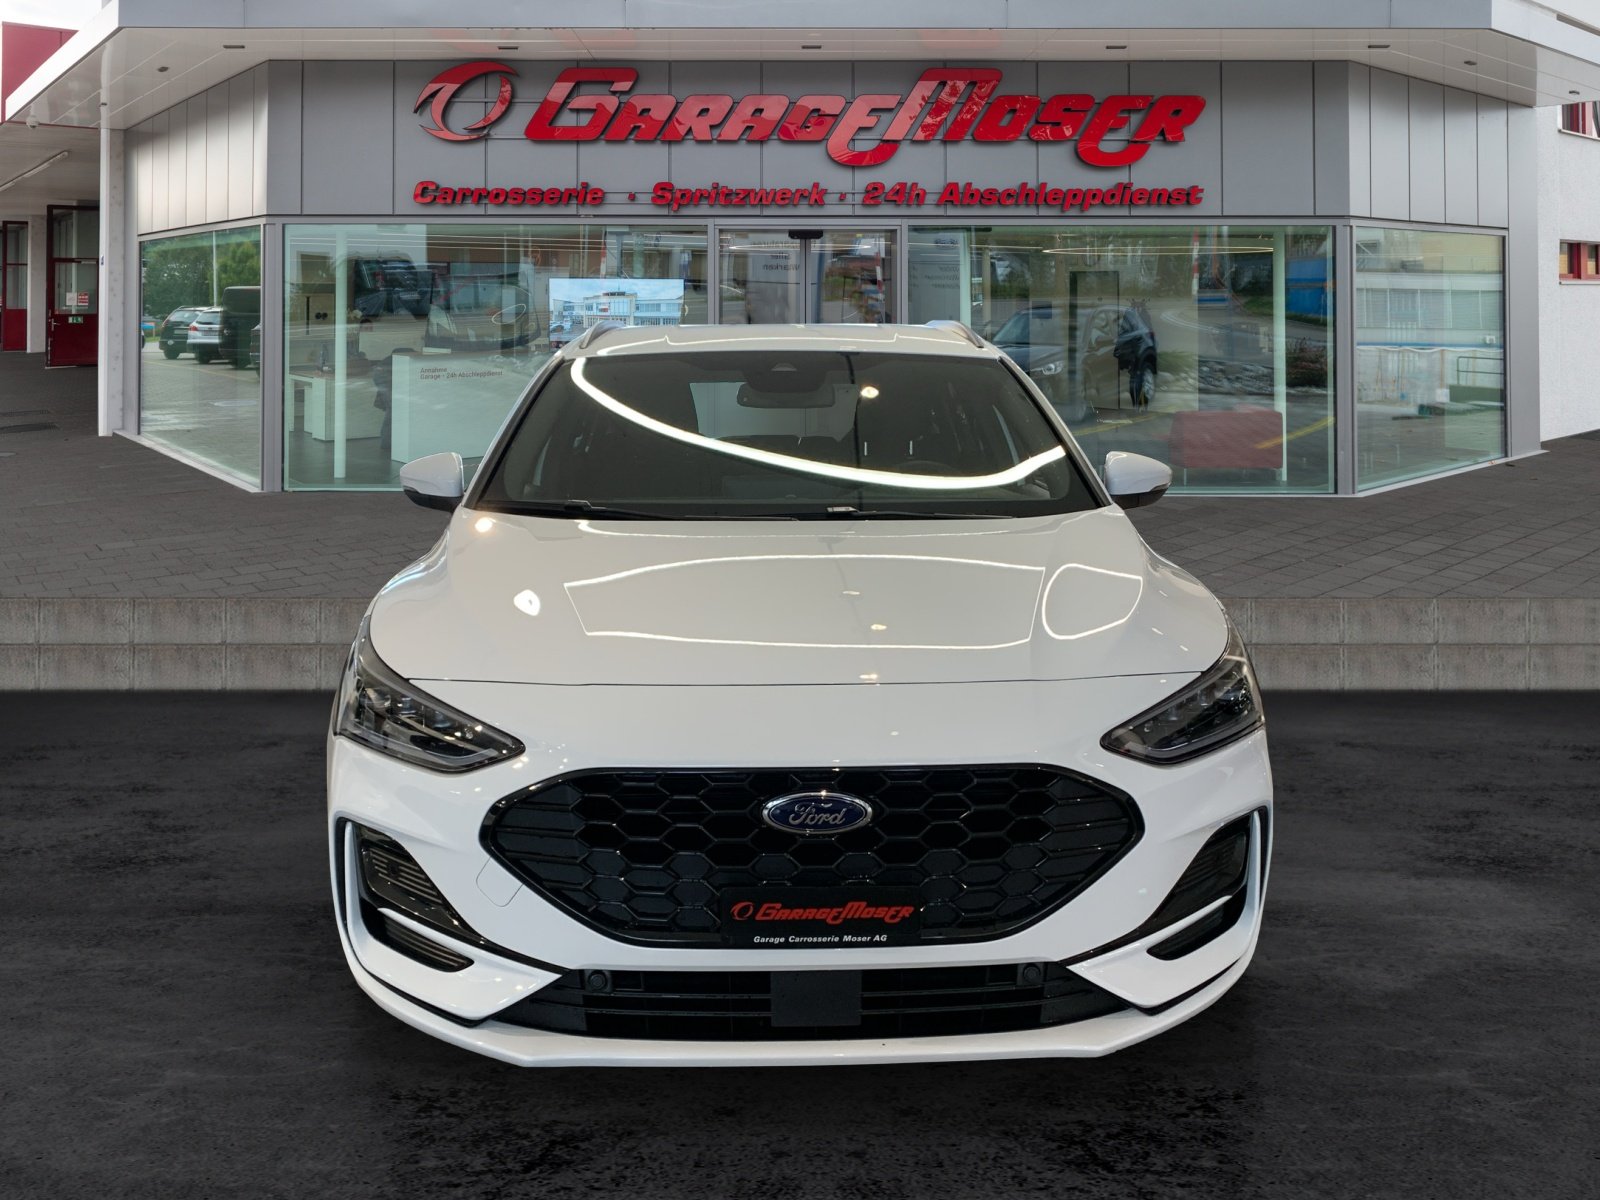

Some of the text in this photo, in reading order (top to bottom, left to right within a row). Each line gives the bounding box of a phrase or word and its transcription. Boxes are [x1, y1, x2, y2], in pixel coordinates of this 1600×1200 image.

[413, 181, 1204, 212] Carrosserie Spritzwerk 24h Abschleppdienst
[458, 370, 503, 379] Abschleppdienst
[788, 802, 847, 825] Ford
[753, 935, 786, 944] Garage
[788, 935, 840, 943] Carrosserie
[872, 934, 888, 942] AG
